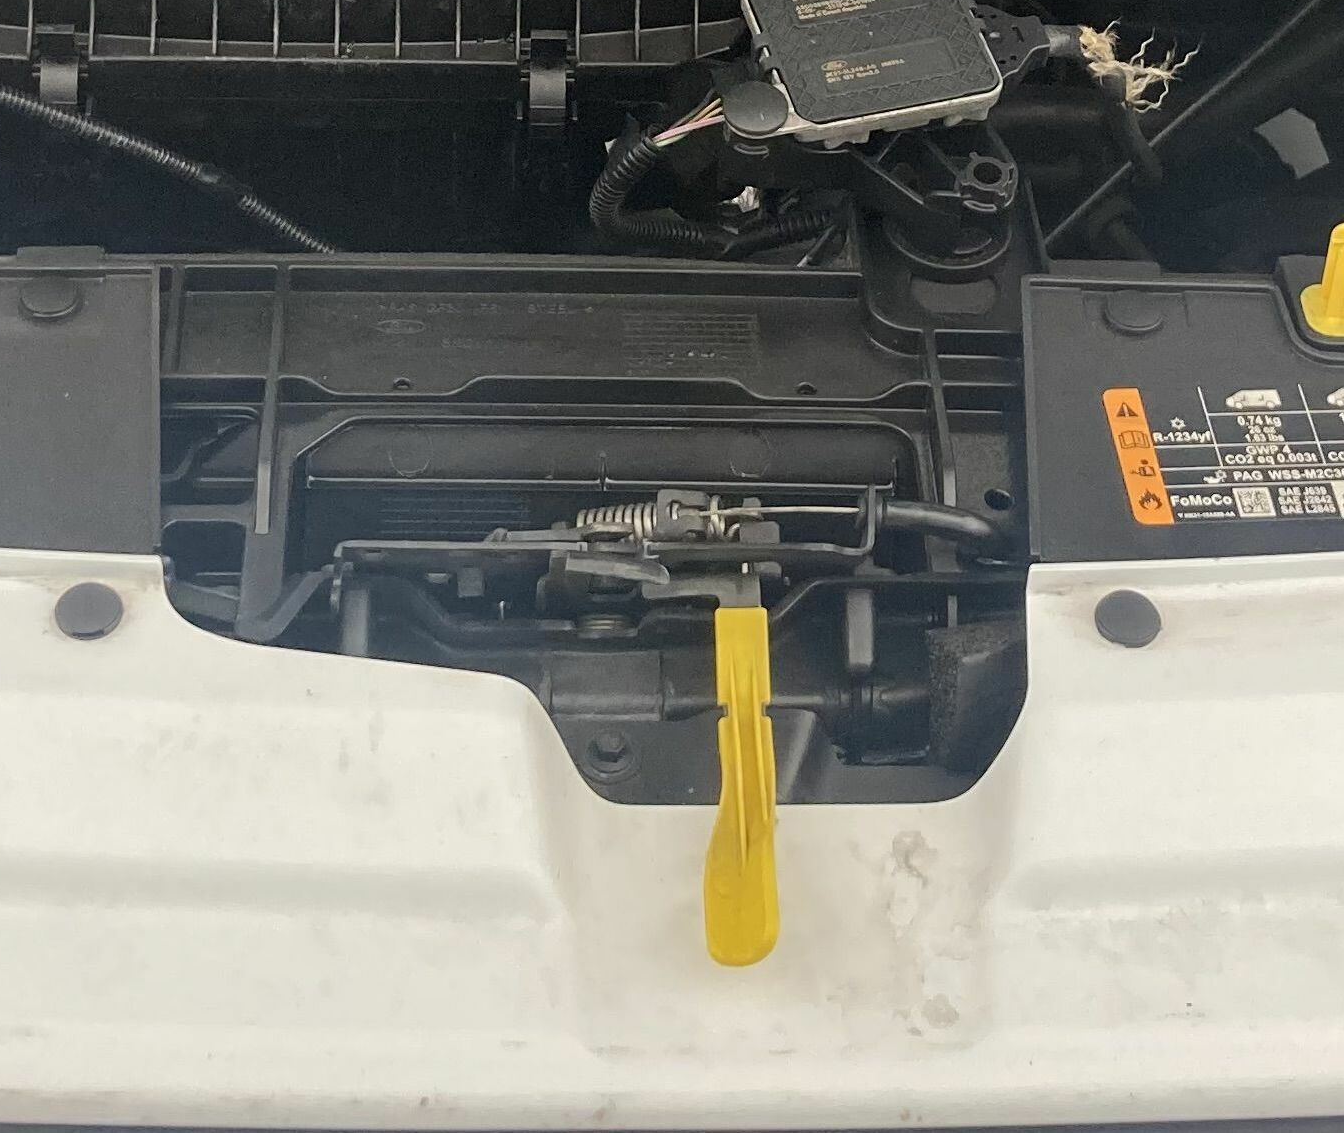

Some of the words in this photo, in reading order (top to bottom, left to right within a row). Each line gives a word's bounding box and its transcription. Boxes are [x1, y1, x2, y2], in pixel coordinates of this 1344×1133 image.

[1237, 416, 1263, 426] 0.74
[1266, 416, 1282, 427] kg
[1246, 445, 1279, 455] GWP
[1282, 444, 1292, 454] 4
[1225, 454, 1255, 464] CO2
[1232, 470, 1263, 482] PAG
[1170, 493, 1233, 508] FoMoCo
